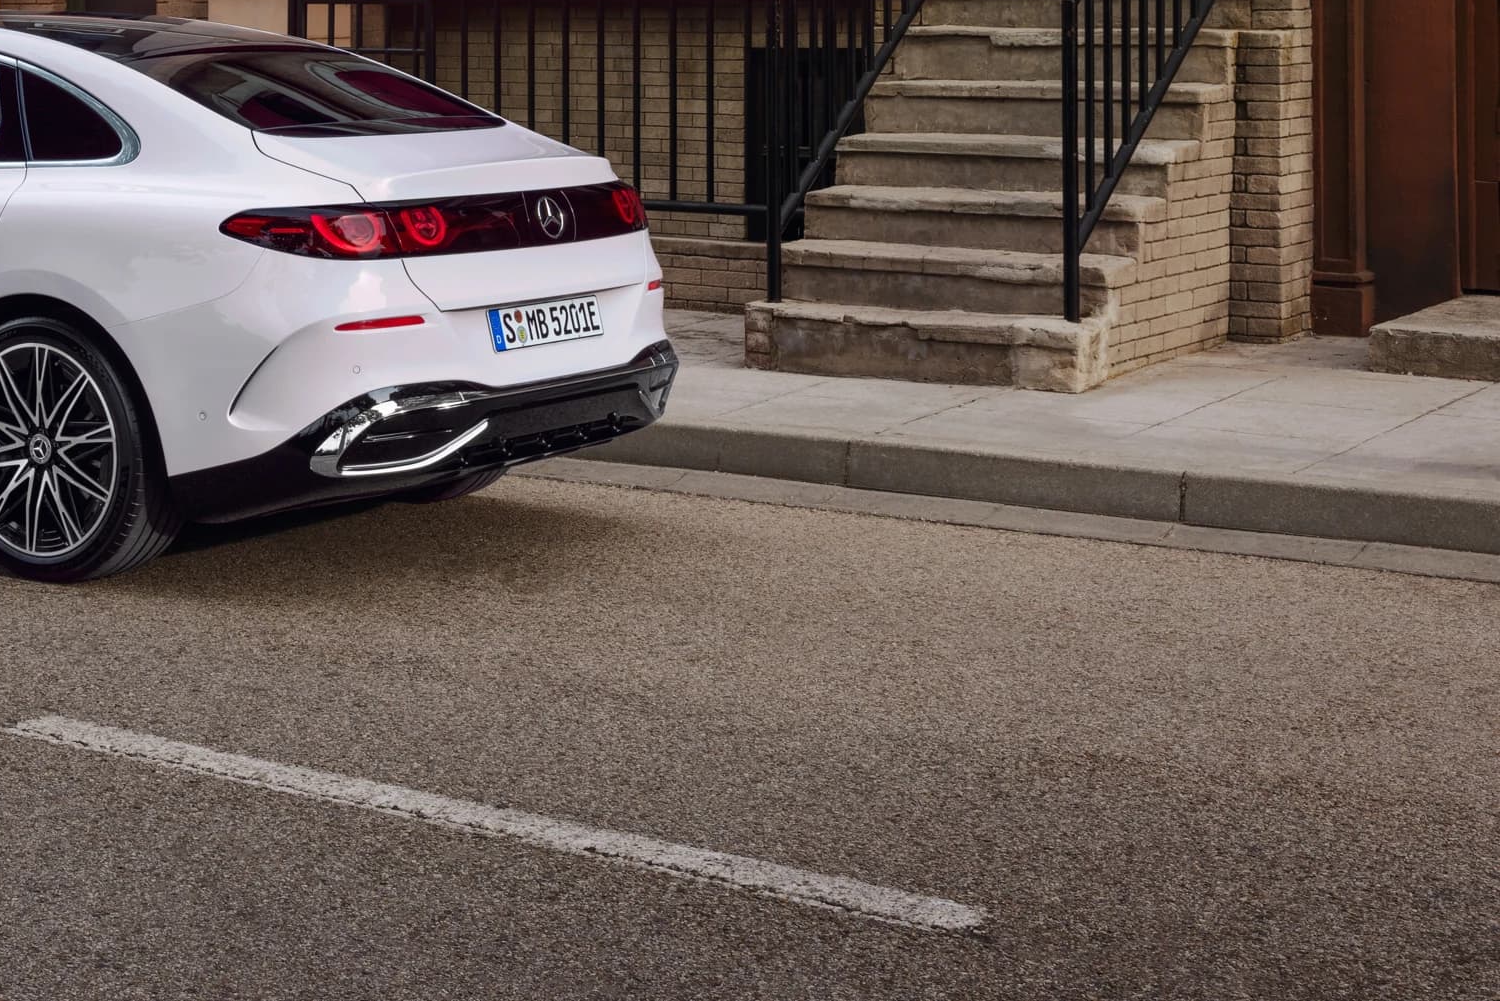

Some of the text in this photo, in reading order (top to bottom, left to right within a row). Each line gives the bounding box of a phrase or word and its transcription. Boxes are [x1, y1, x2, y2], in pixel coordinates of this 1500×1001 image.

[503, 301, 600, 343] S MB 5201E
